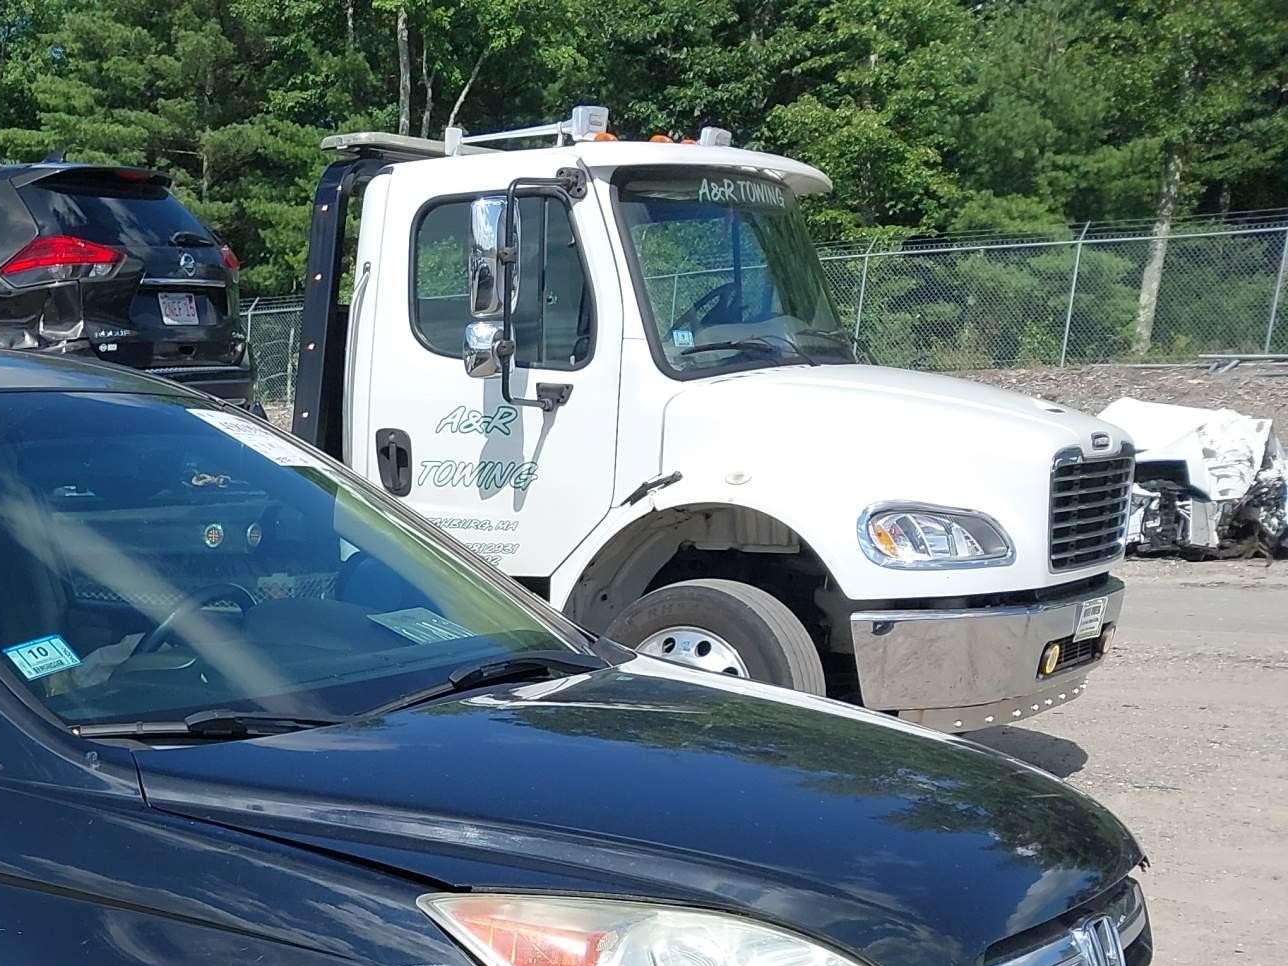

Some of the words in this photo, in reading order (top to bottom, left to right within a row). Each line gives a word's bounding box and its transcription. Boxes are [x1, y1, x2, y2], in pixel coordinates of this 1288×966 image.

[699, 178, 737, 202] A&R
[736, 180, 785, 208] TOWING
[435, 405, 518, 436] A&R
[418, 459, 538, 491] TOWING
[495, 520, 520, 531] MA
[27, 646, 49, 660] 10
